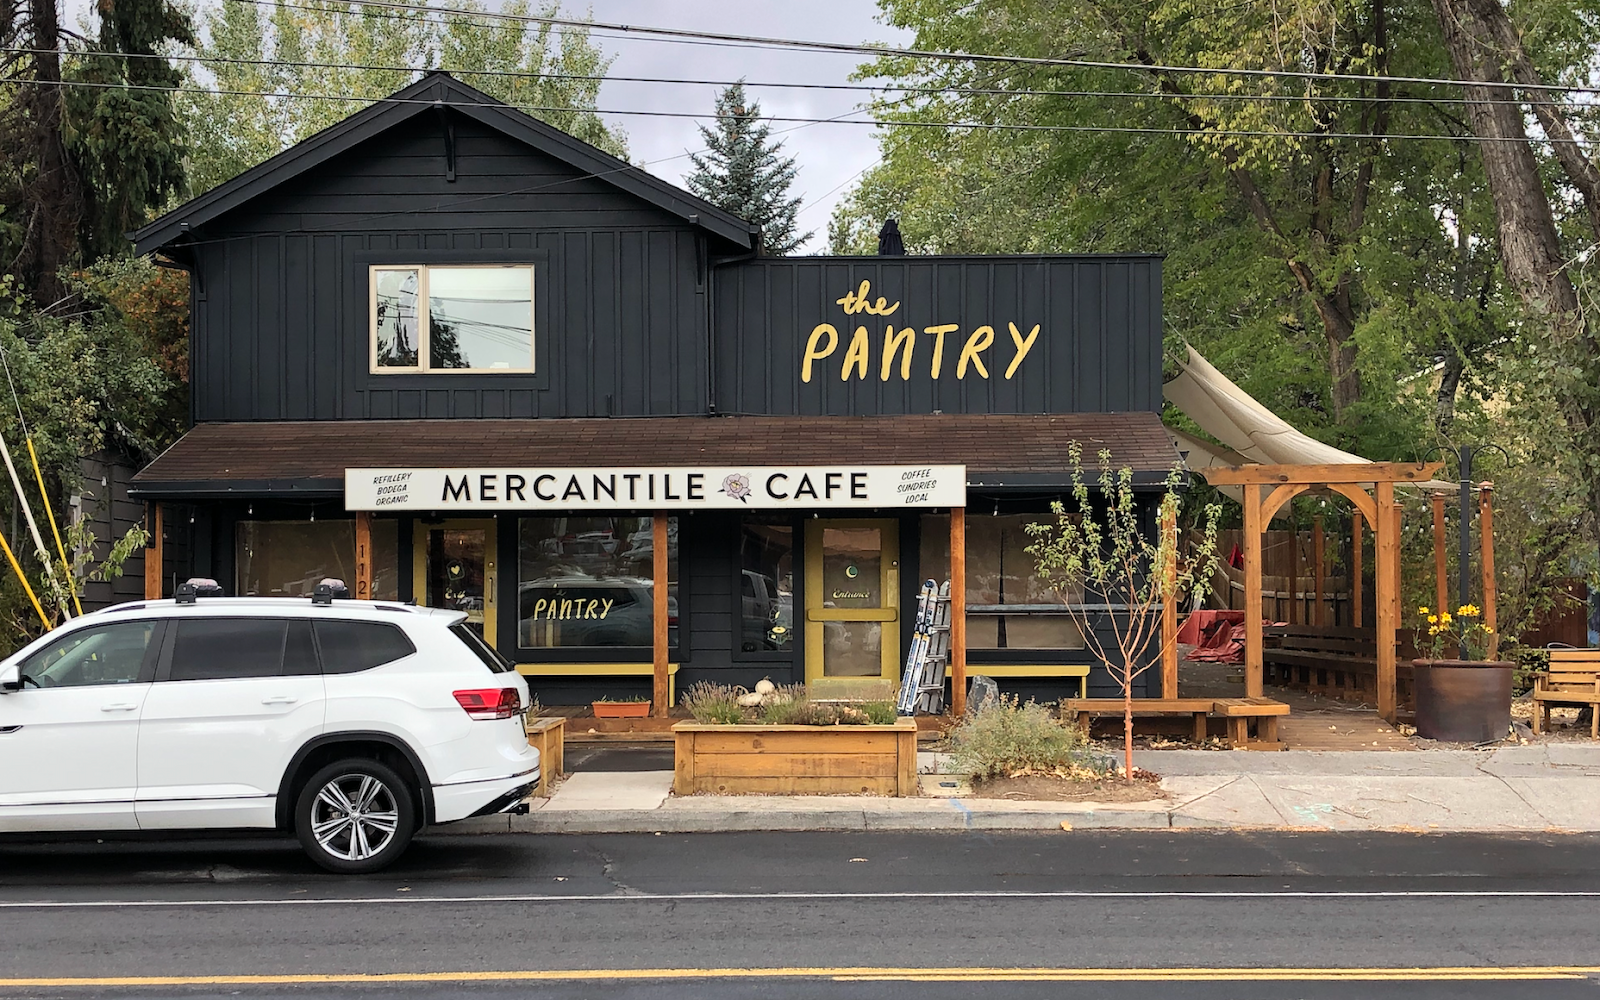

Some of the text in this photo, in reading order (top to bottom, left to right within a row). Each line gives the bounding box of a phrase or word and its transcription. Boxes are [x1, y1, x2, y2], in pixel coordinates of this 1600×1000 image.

[836, 279, 900, 316] the
[801, 321, 1041, 383] PANTRY
[373, 472, 412, 484] REFILLERY
[901, 469, 931, 481] COFFEE
[377, 484, 407, 495] BODEGA
[441, 472, 870, 502] MERCANTILE CAFE
[897, 480, 937, 493] SUNDRIES
[376, 494, 408, 506] ORGANIC
[905, 493, 928, 504] LOCAL
[832, 588, 871, 599] Entrance
[533, 597, 614, 621] PANTRY
